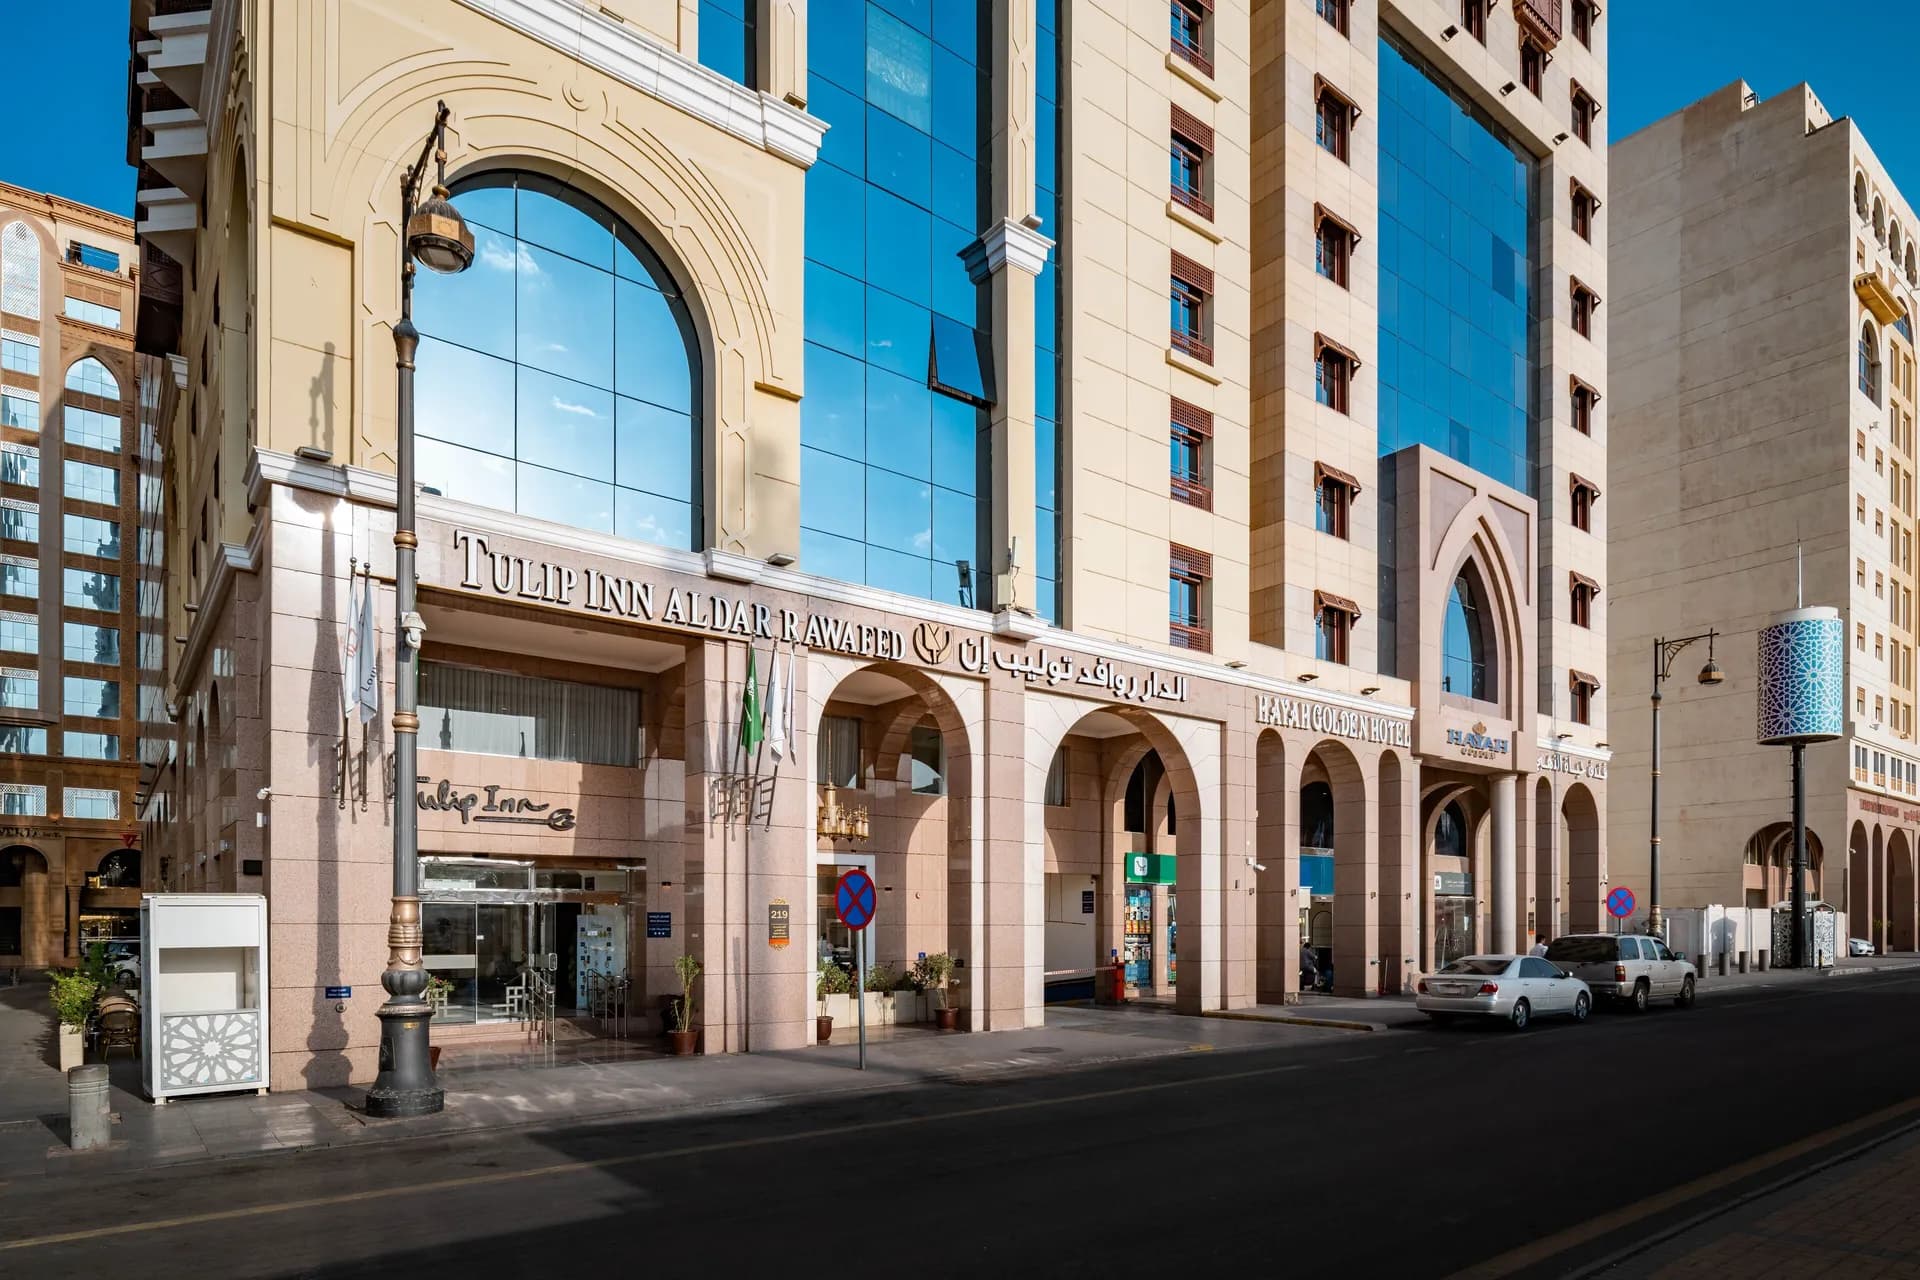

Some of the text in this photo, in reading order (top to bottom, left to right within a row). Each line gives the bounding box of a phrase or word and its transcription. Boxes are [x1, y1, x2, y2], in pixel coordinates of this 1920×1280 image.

[780, 608, 907, 661] RAWAFED
[958, 635, 1188, 702] الدار روافد توليب إن
[1368, 717, 1411, 748] HOTEL
[416, 776, 549, 824] ulip Inn
[771, 910, 788, 919] 219
